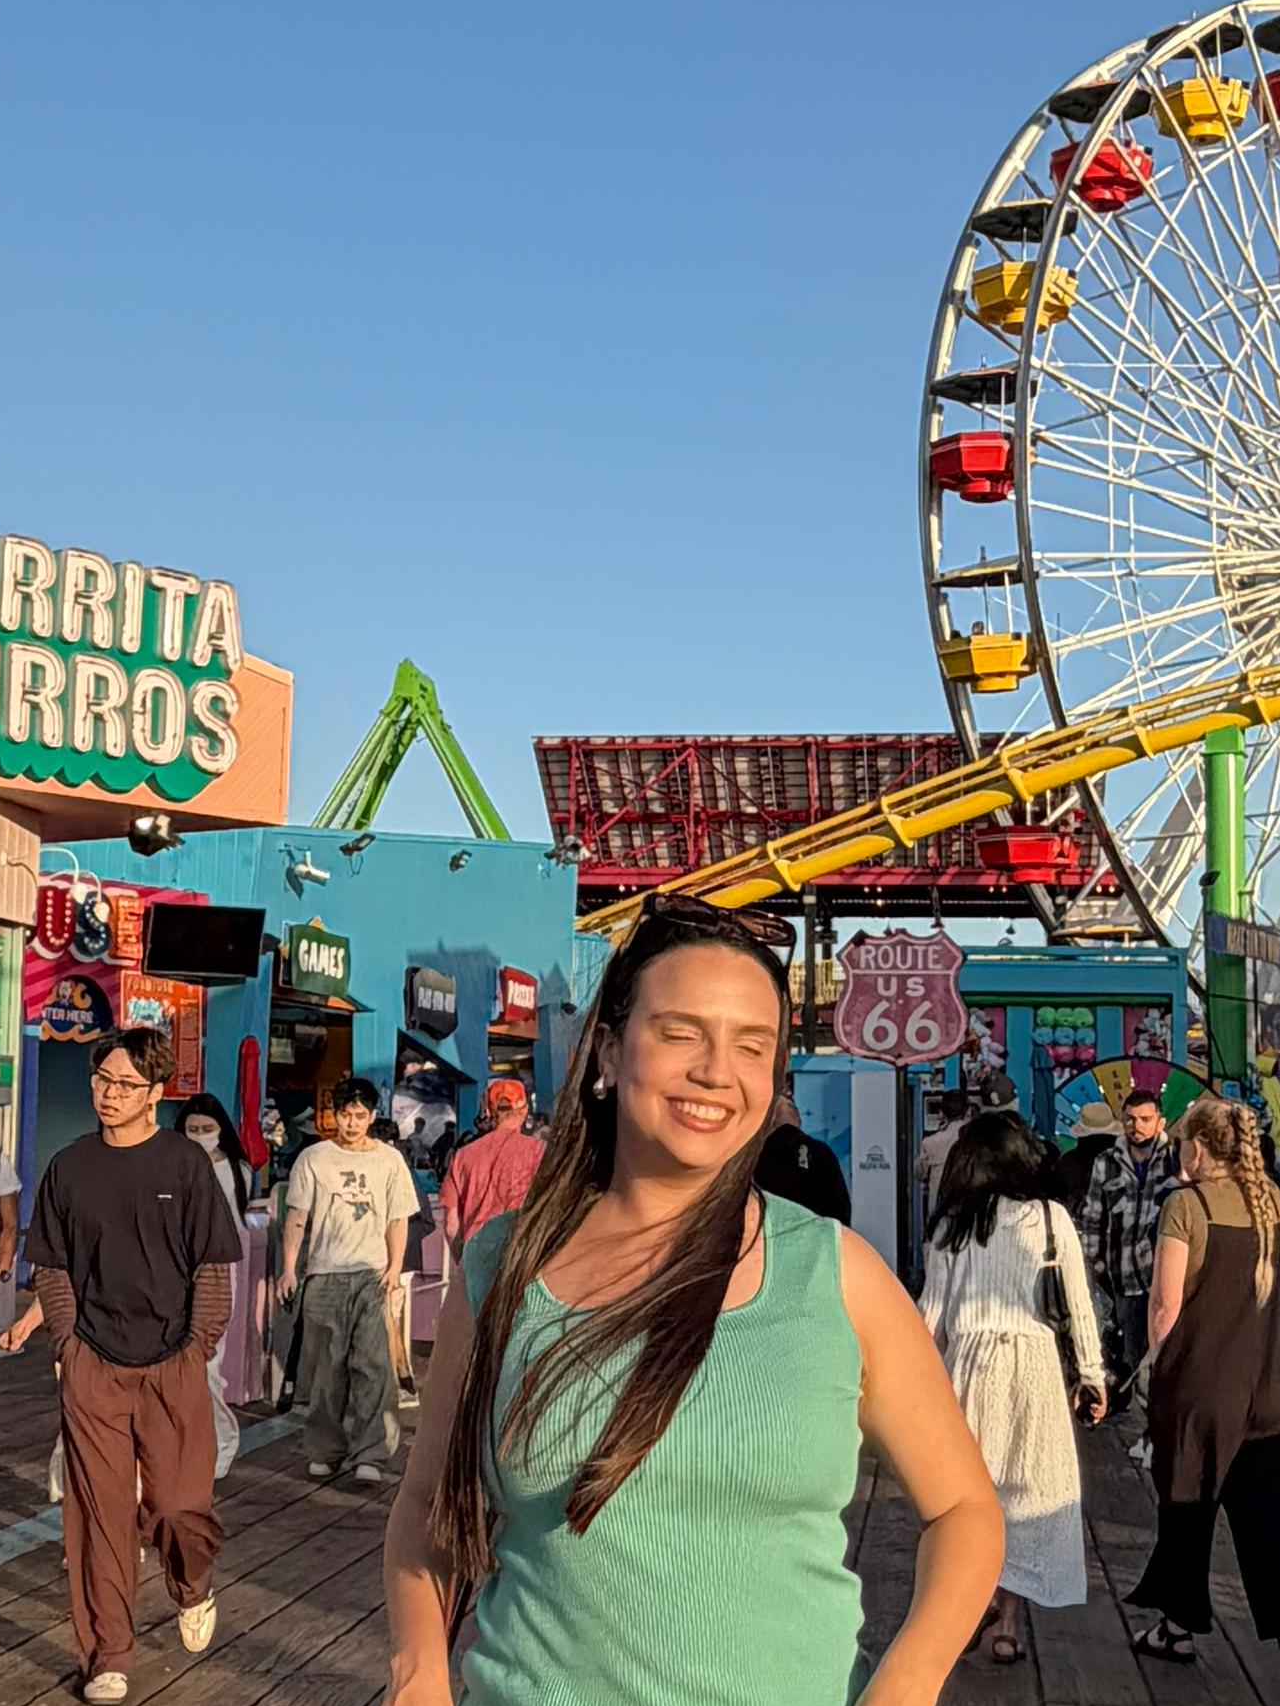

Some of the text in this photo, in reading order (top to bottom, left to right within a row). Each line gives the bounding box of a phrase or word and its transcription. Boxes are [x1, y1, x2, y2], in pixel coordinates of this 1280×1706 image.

[28, 883, 143, 959] USE
[298, 938, 346, 980] GAMES
[859, 944, 944, 970] ROUTE
[876, 976, 926, 997] US
[862, 998, 941, 1052] 66
